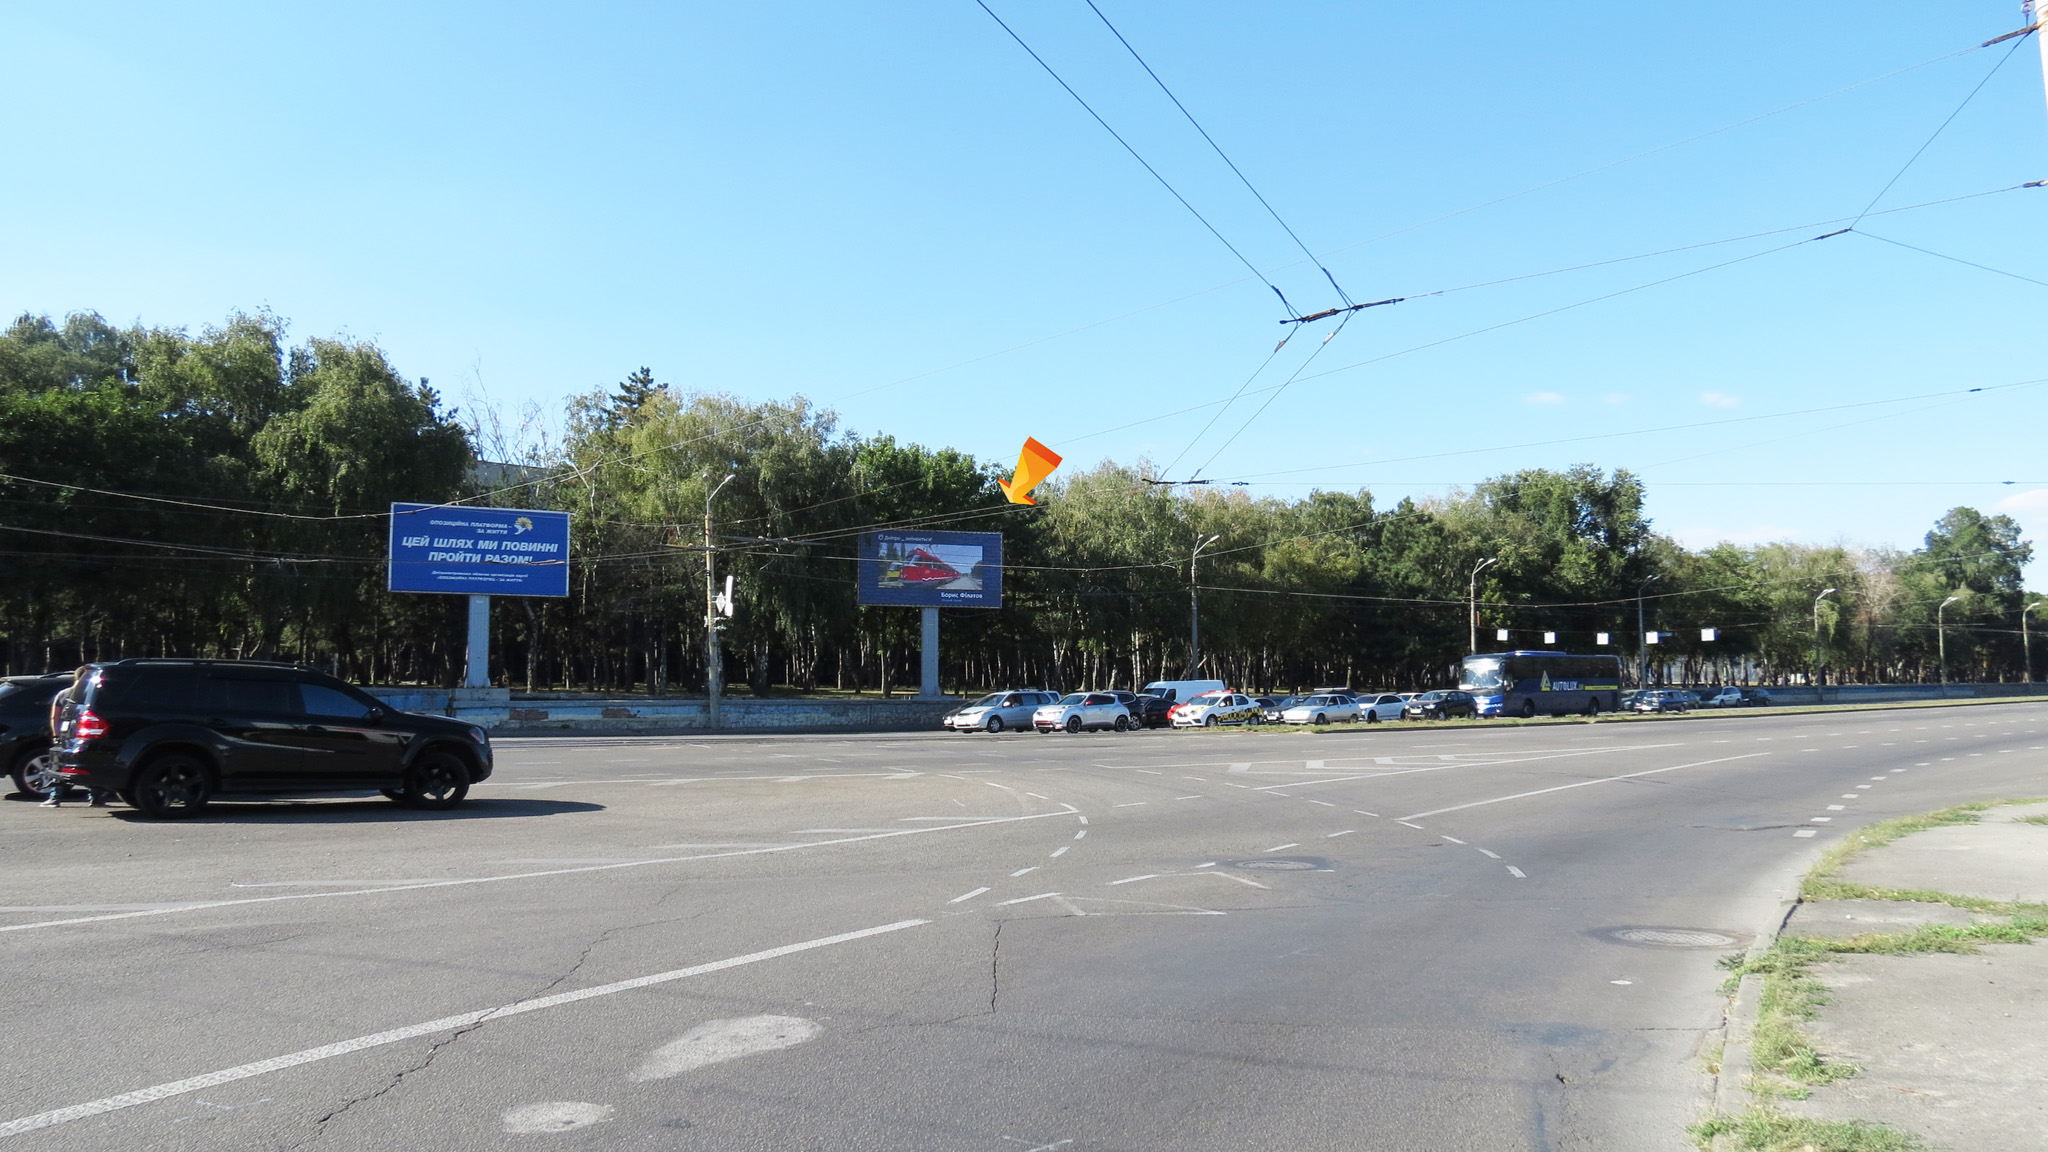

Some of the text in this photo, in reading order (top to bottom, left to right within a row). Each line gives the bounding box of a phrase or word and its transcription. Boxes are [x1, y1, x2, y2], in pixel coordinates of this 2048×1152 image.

[401, 535, 559, 553] ЦЕЙ ШЛЯХ МИ ПОВИННІ
[428, 551, 534, 565] ПРОЙТИ РАЗОМ!
